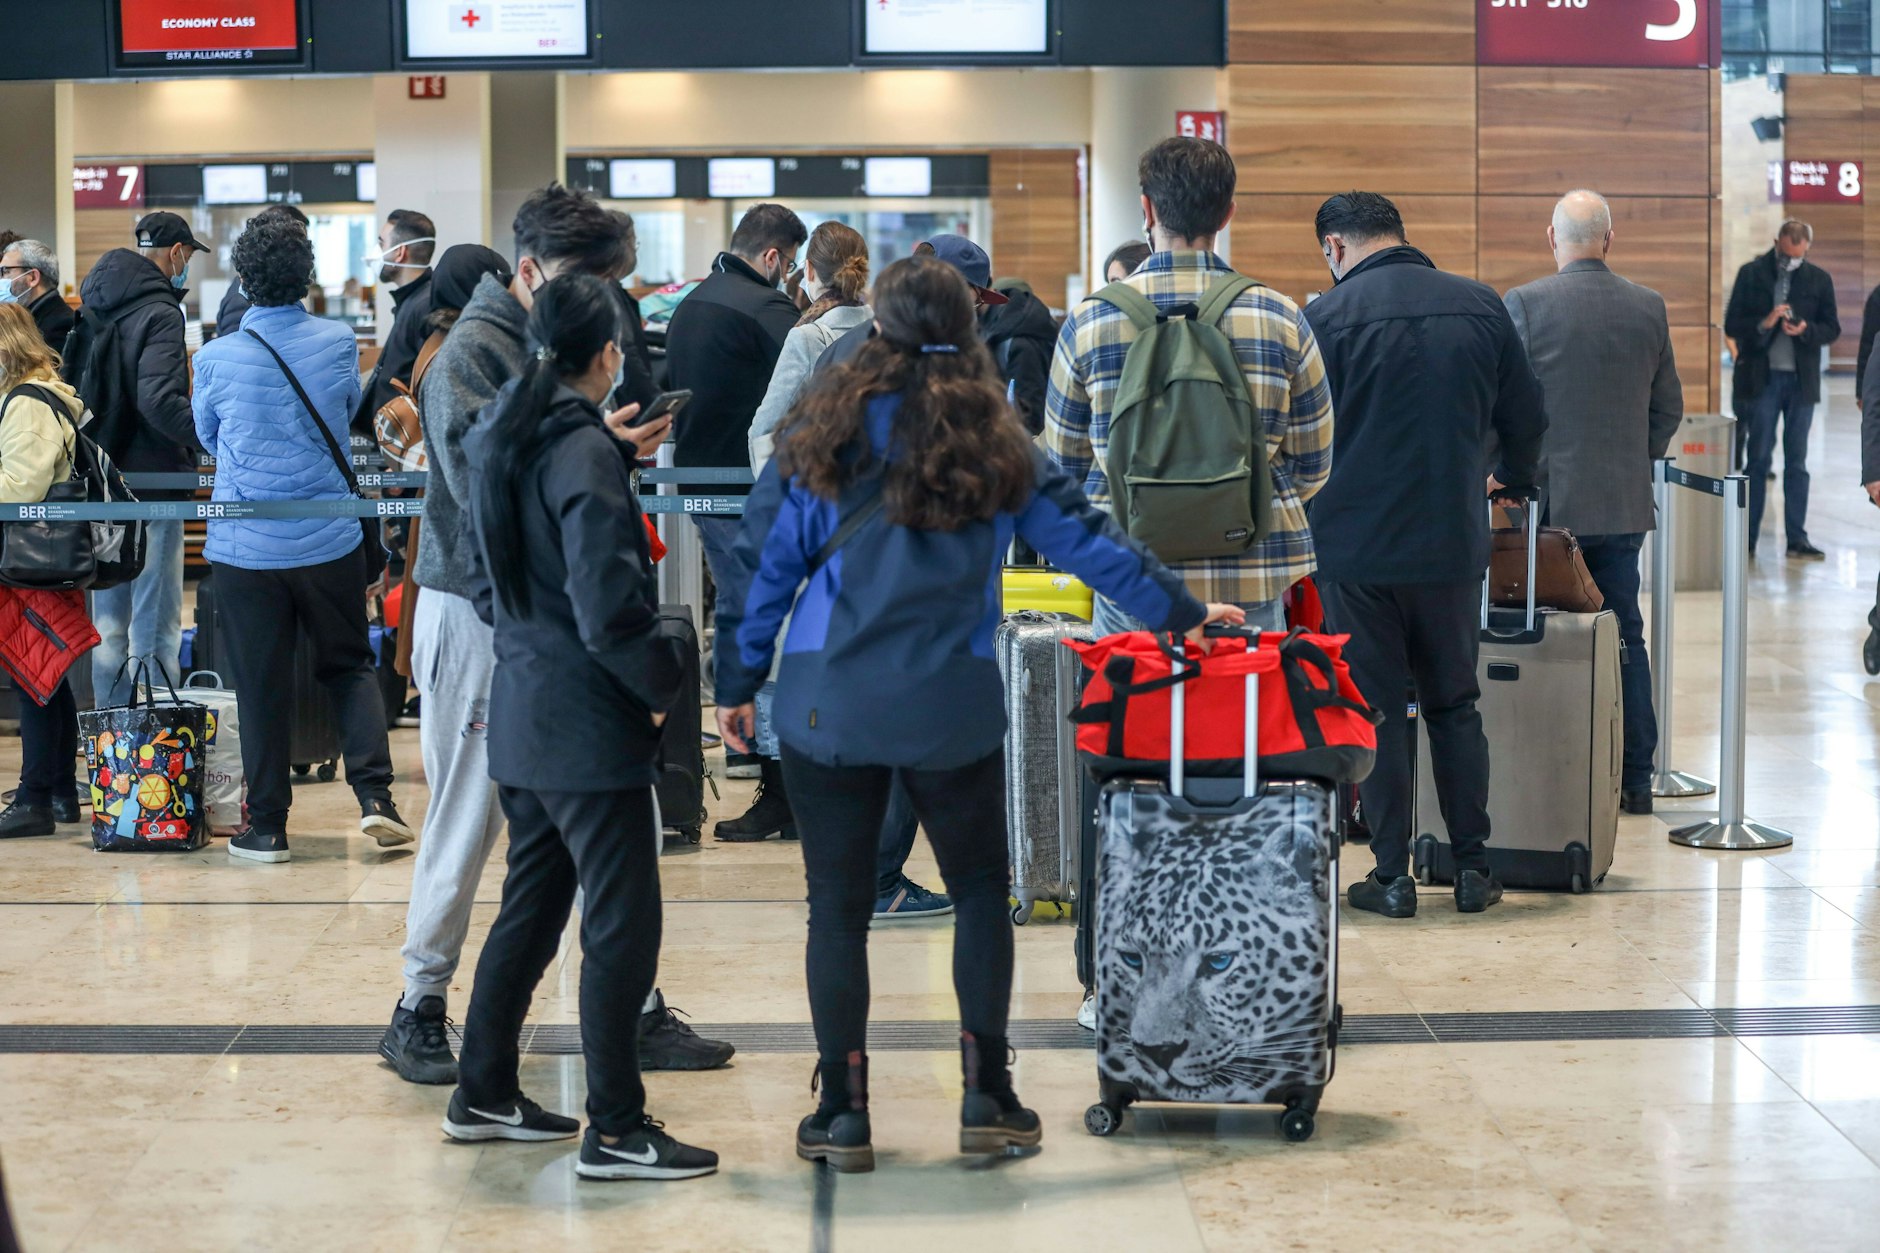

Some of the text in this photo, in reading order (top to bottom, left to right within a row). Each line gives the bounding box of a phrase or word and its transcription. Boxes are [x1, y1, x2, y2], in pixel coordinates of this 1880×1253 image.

[161, 17, 256, 29] ECONOMY CLASS
[165, 50, 242, 60] STAR ALLIANCE
[117, 166, 139, 201] 7
[1838, 162, 1860, 197] 8
[1683, 443, 1705, 454] BER
[201, 455, 216, 466] BE
[353, 455, 367, 465] ER
[199, 476, 214, 487] BE
[357, 474, 381, 486] BER
[197, 504, 224, 517] BER
[377, 502, 404, 514] BER
[684, 499, 712, 511] BER
[19, 505, 46, 518] BER
[204, 770, 231, 783] hön
